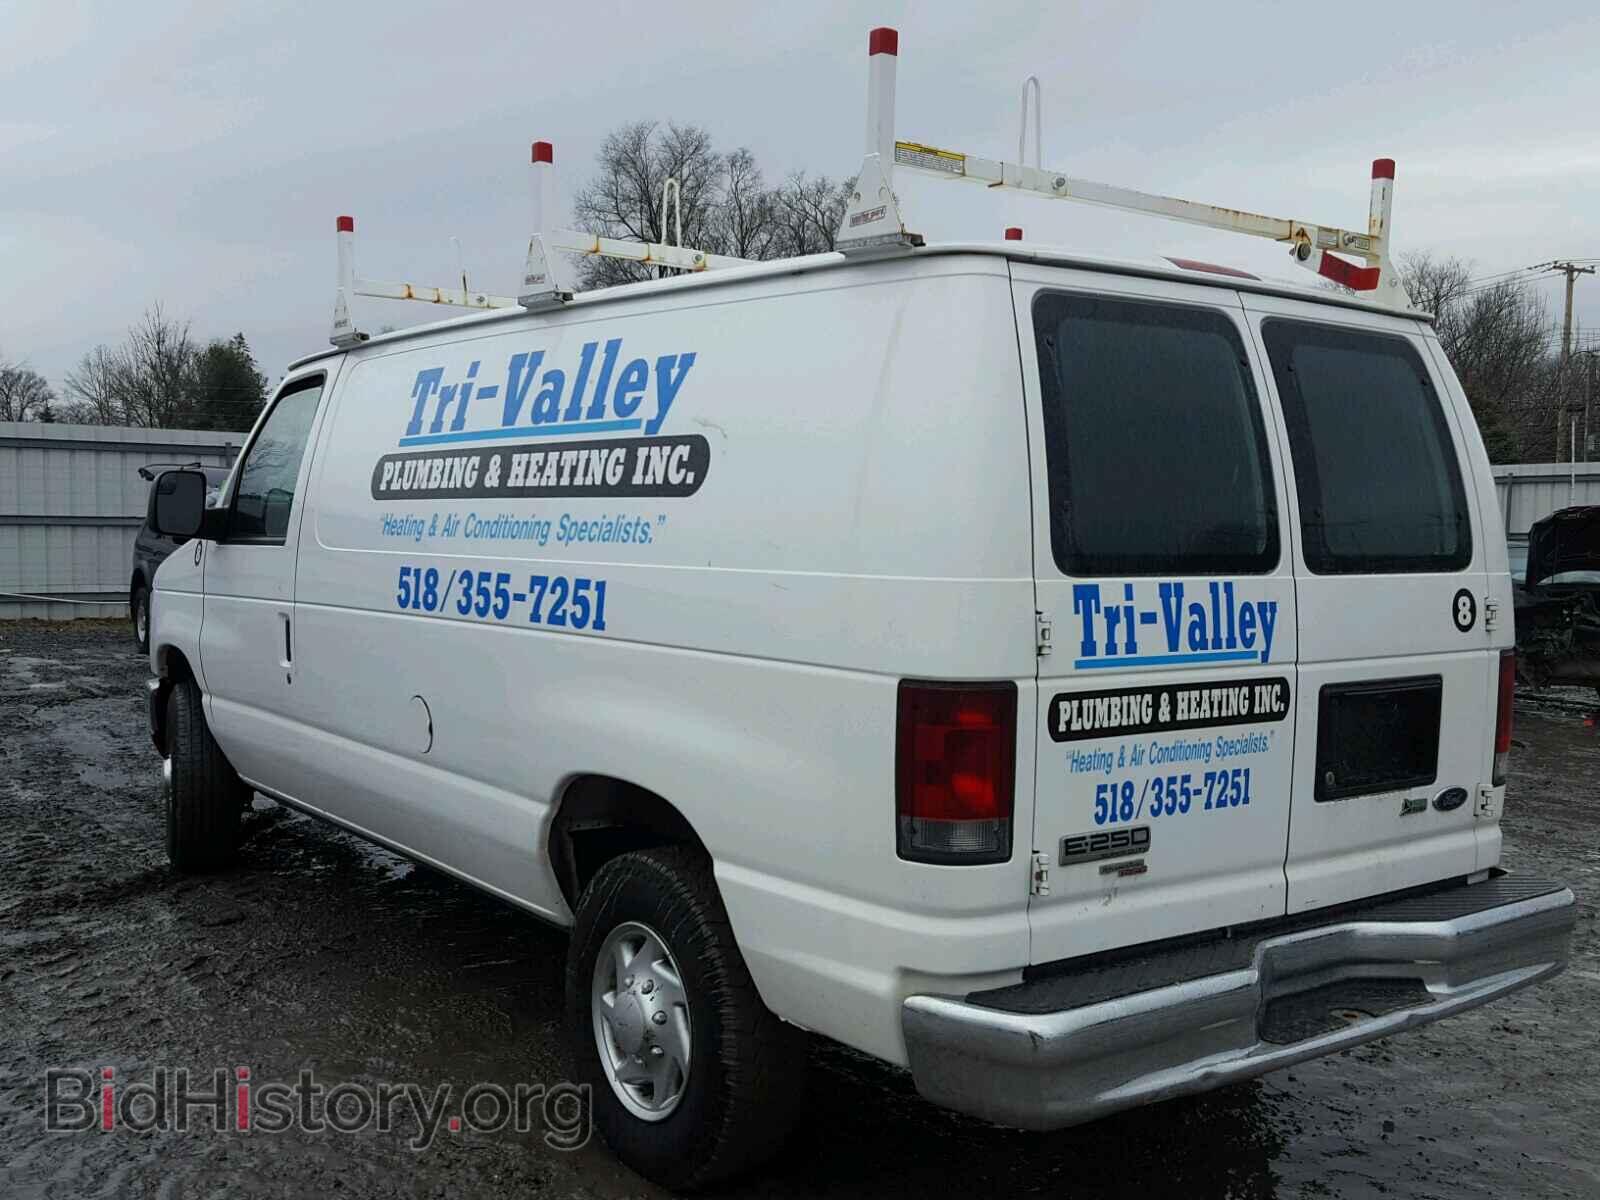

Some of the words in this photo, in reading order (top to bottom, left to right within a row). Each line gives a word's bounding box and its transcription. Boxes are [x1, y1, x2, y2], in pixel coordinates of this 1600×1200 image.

[405, 338, 698, 435] Tri-Valley
[379, 455, 481, 491] PLUMBING
[484, 454, 502, 488] &
[506, 447, 627, 487] HEATING
[632, 445, 696, 485] INC.
[428, 513, 439, 537] &
[440, 513, 460, 538] Air
[464, 512, 551, 546] Conditioning
[396, 566, 607, 631] 518/355-7251
[1072, 581, 1278, 664] Tri-Valley
[1457, 595, 1472, 626] 8
[1058, 693, 1153, 732] PLUMBING
[1158, 691, 1171, 723] &
[1176, 686, 1249, 720] HEATING
[1254, 684, 1285, 714] INC.
[1117, 745, 1126, 768] &
[1130, 743, 1145, 767] Air
[1149, 737, 1212, 764] Conditioning
[1094, 767, 1250, 826] 518/355-7251
